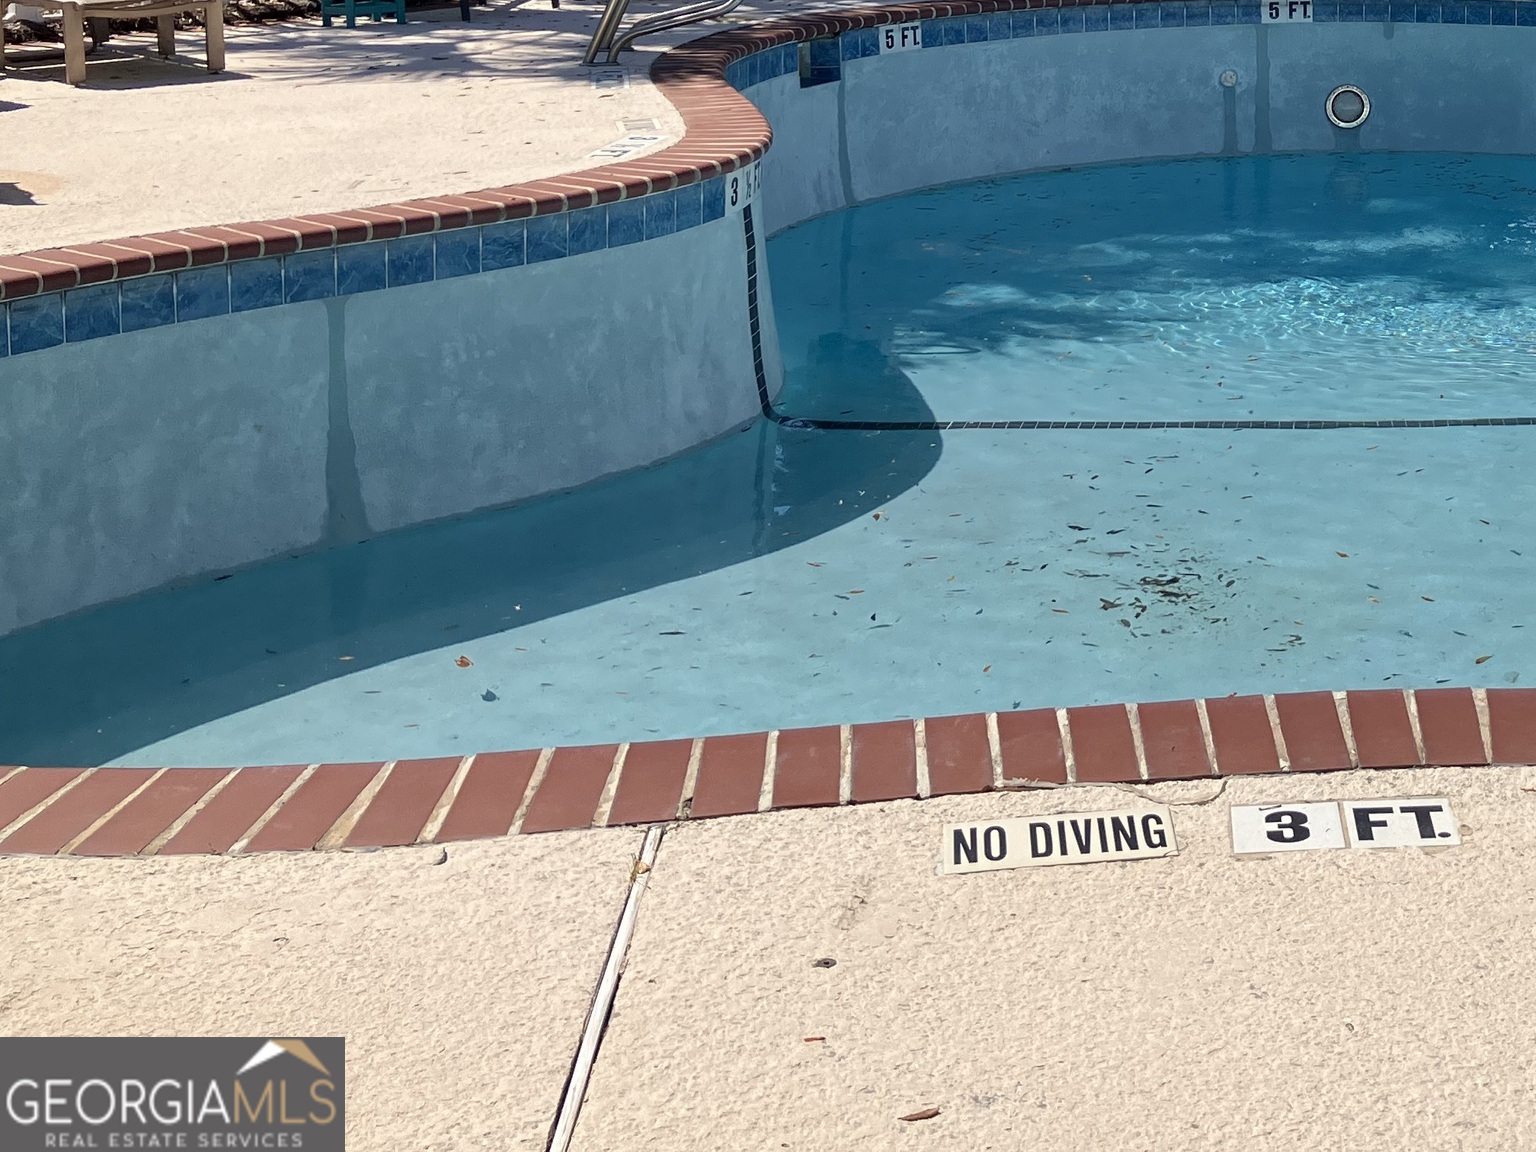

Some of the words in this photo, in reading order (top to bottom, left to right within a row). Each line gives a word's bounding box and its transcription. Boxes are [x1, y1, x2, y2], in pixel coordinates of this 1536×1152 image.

[1268, 1, 1280, 19] 5
[1288, 0, 1311, 19] FT.
[885, 28, 895, 49] 5
[901, 25, 920, 48] FT.
[730, 176, 739, 207] 3
[953, 825, 1008, 866] NO
[1029, 813, 1168, 859] DIVING
[1264, 810, 1311, 844] 3
[1352, 804, 1452, 841] FT.
